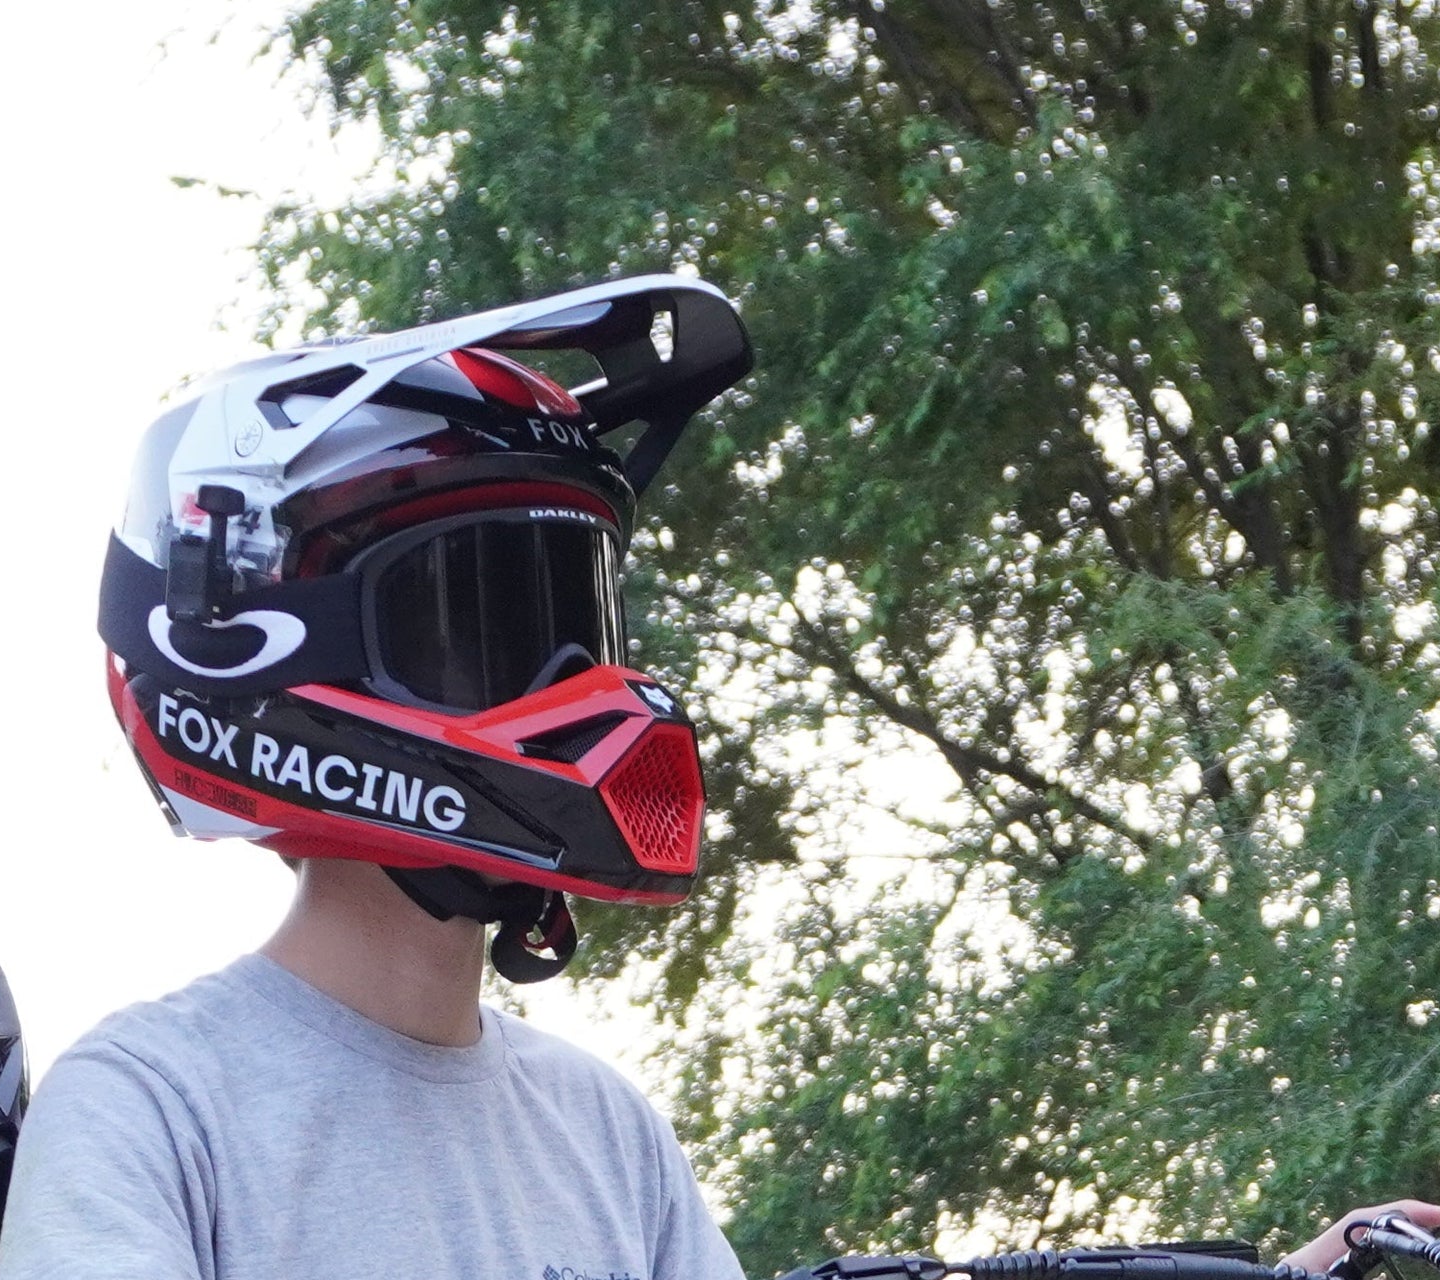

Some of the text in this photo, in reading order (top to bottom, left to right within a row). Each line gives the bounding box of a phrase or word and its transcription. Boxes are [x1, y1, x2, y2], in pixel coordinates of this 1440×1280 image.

[527, 418, 589, 450] FOX
[529, 509, 596, 523] OAKLEY
[160, 692, 239, 769] FOX
[250, 732, 466, 832] RACING
